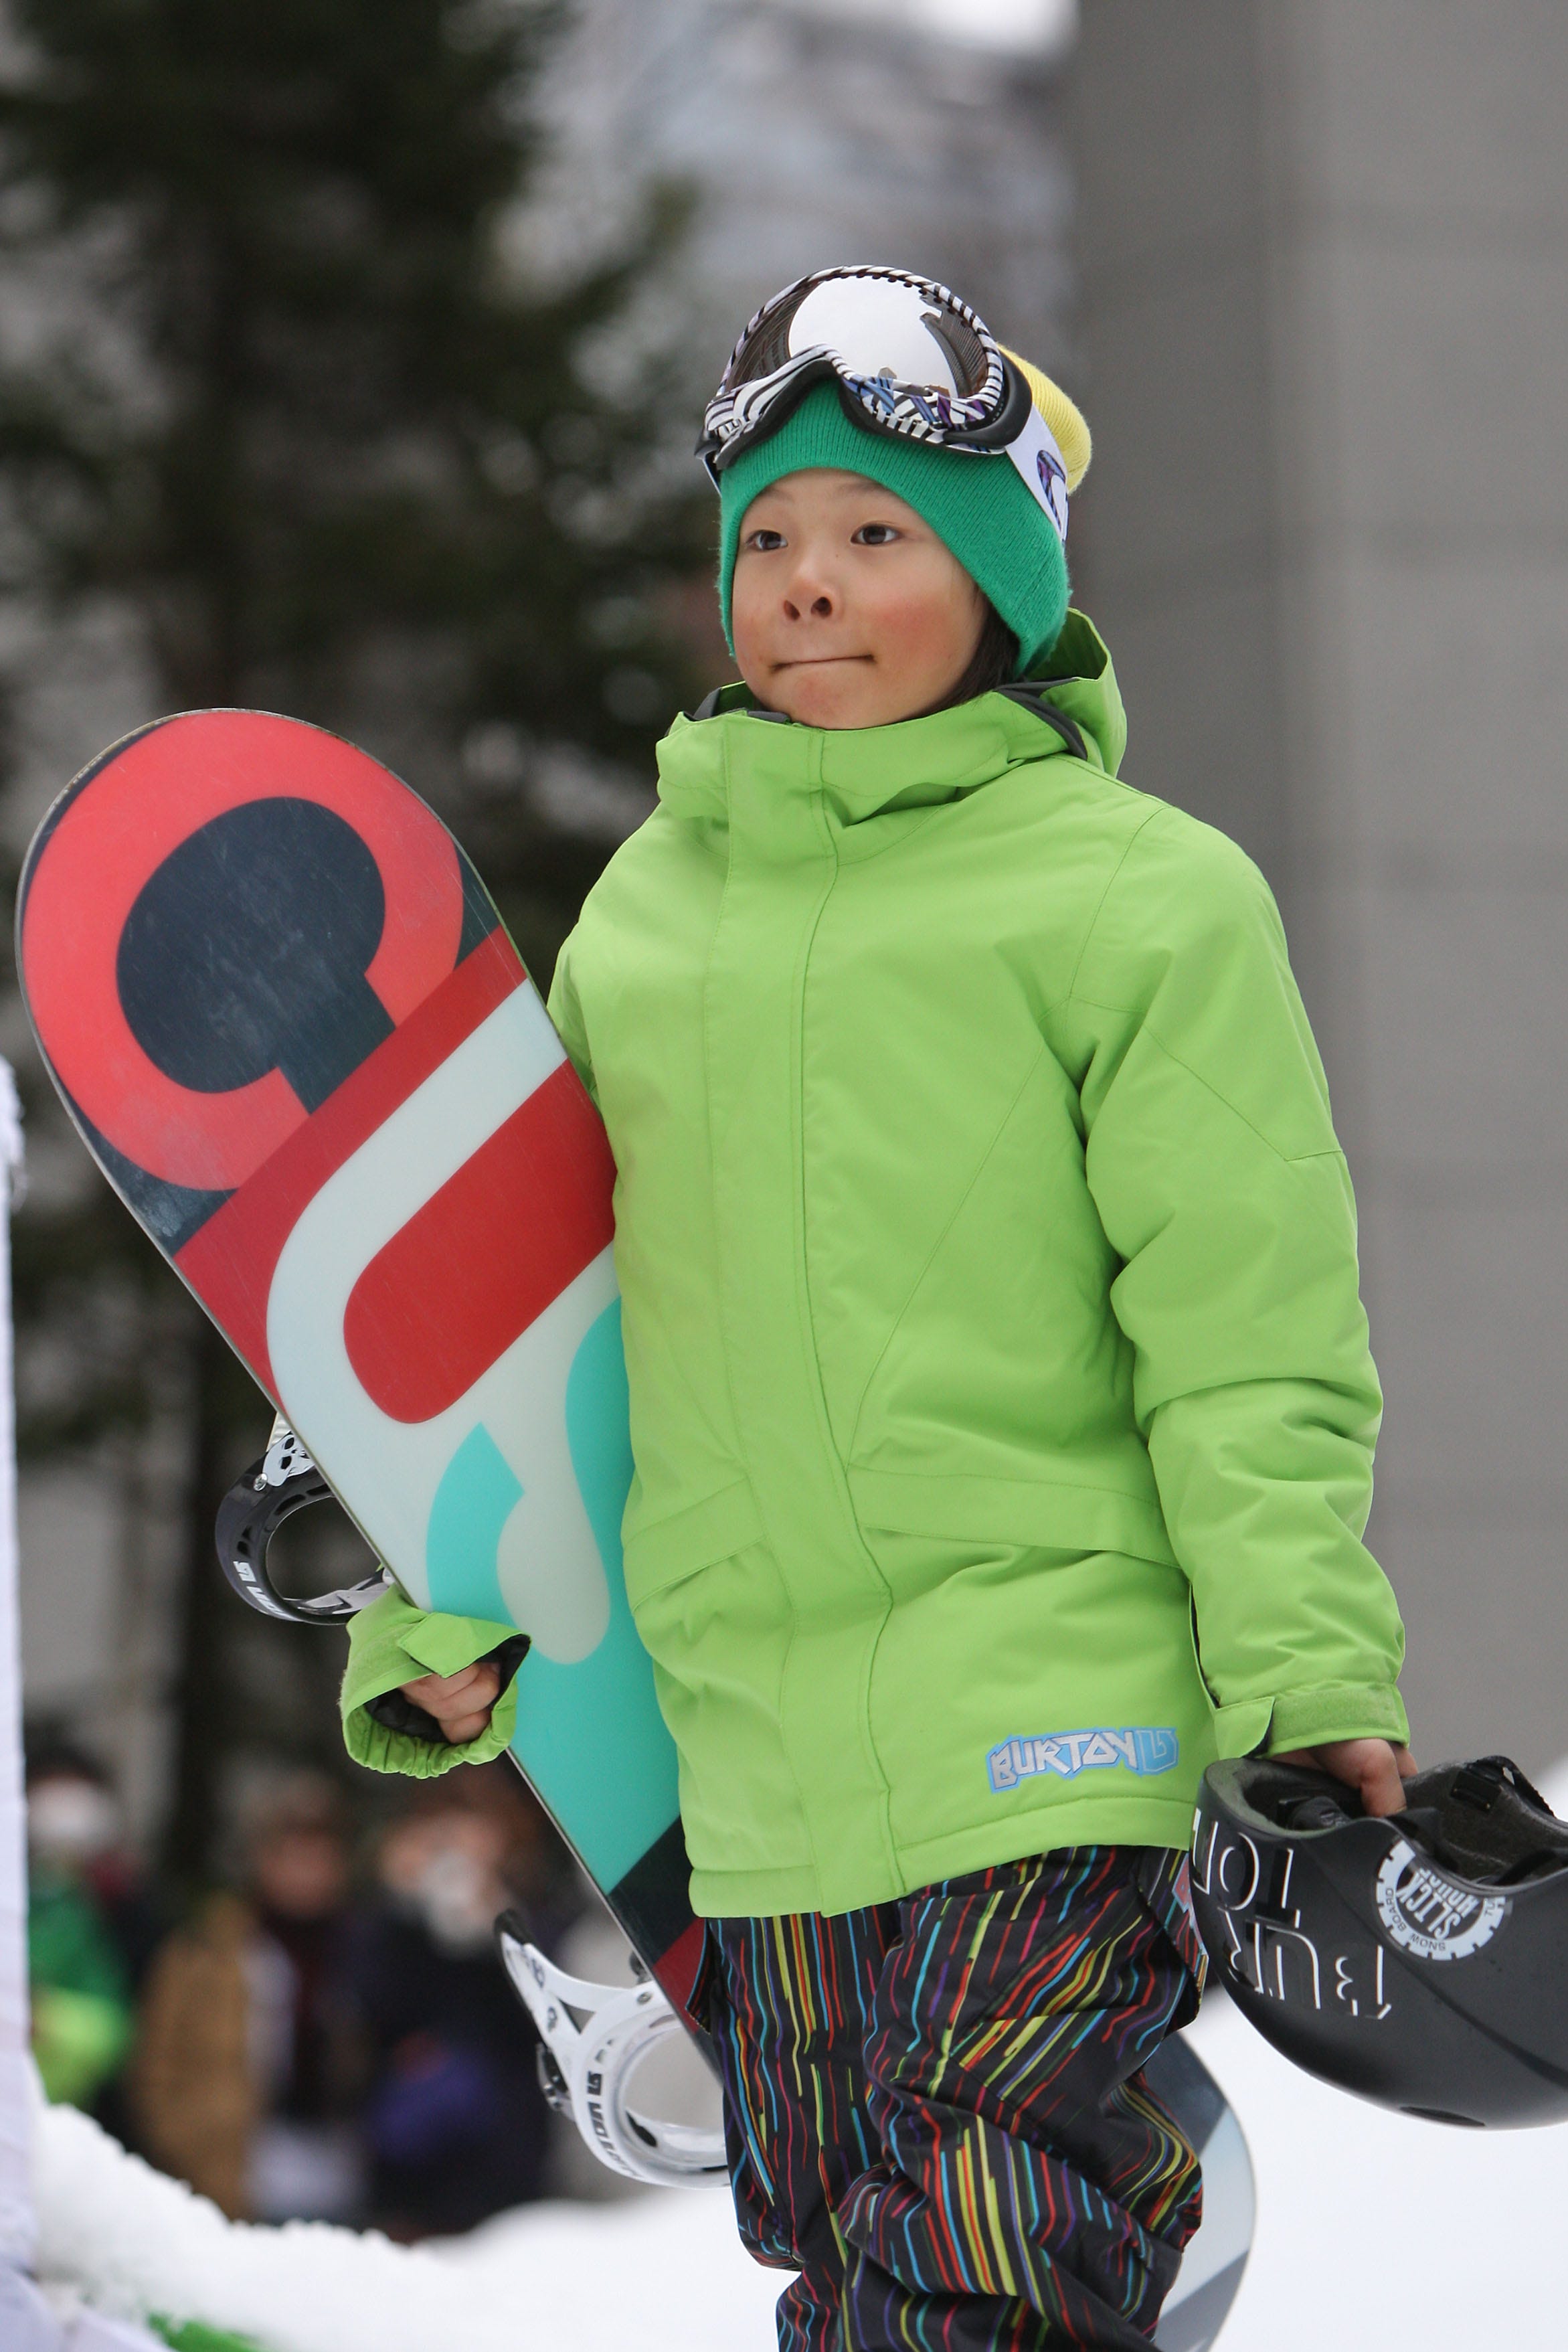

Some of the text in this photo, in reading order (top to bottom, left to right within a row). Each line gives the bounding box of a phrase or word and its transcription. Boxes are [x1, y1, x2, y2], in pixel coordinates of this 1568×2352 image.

[19, 709, 687, 1892] CUS
[988, 1730, 1139, 1790] BURTON
[1395, 1871, 1461, 1940] SLICK
